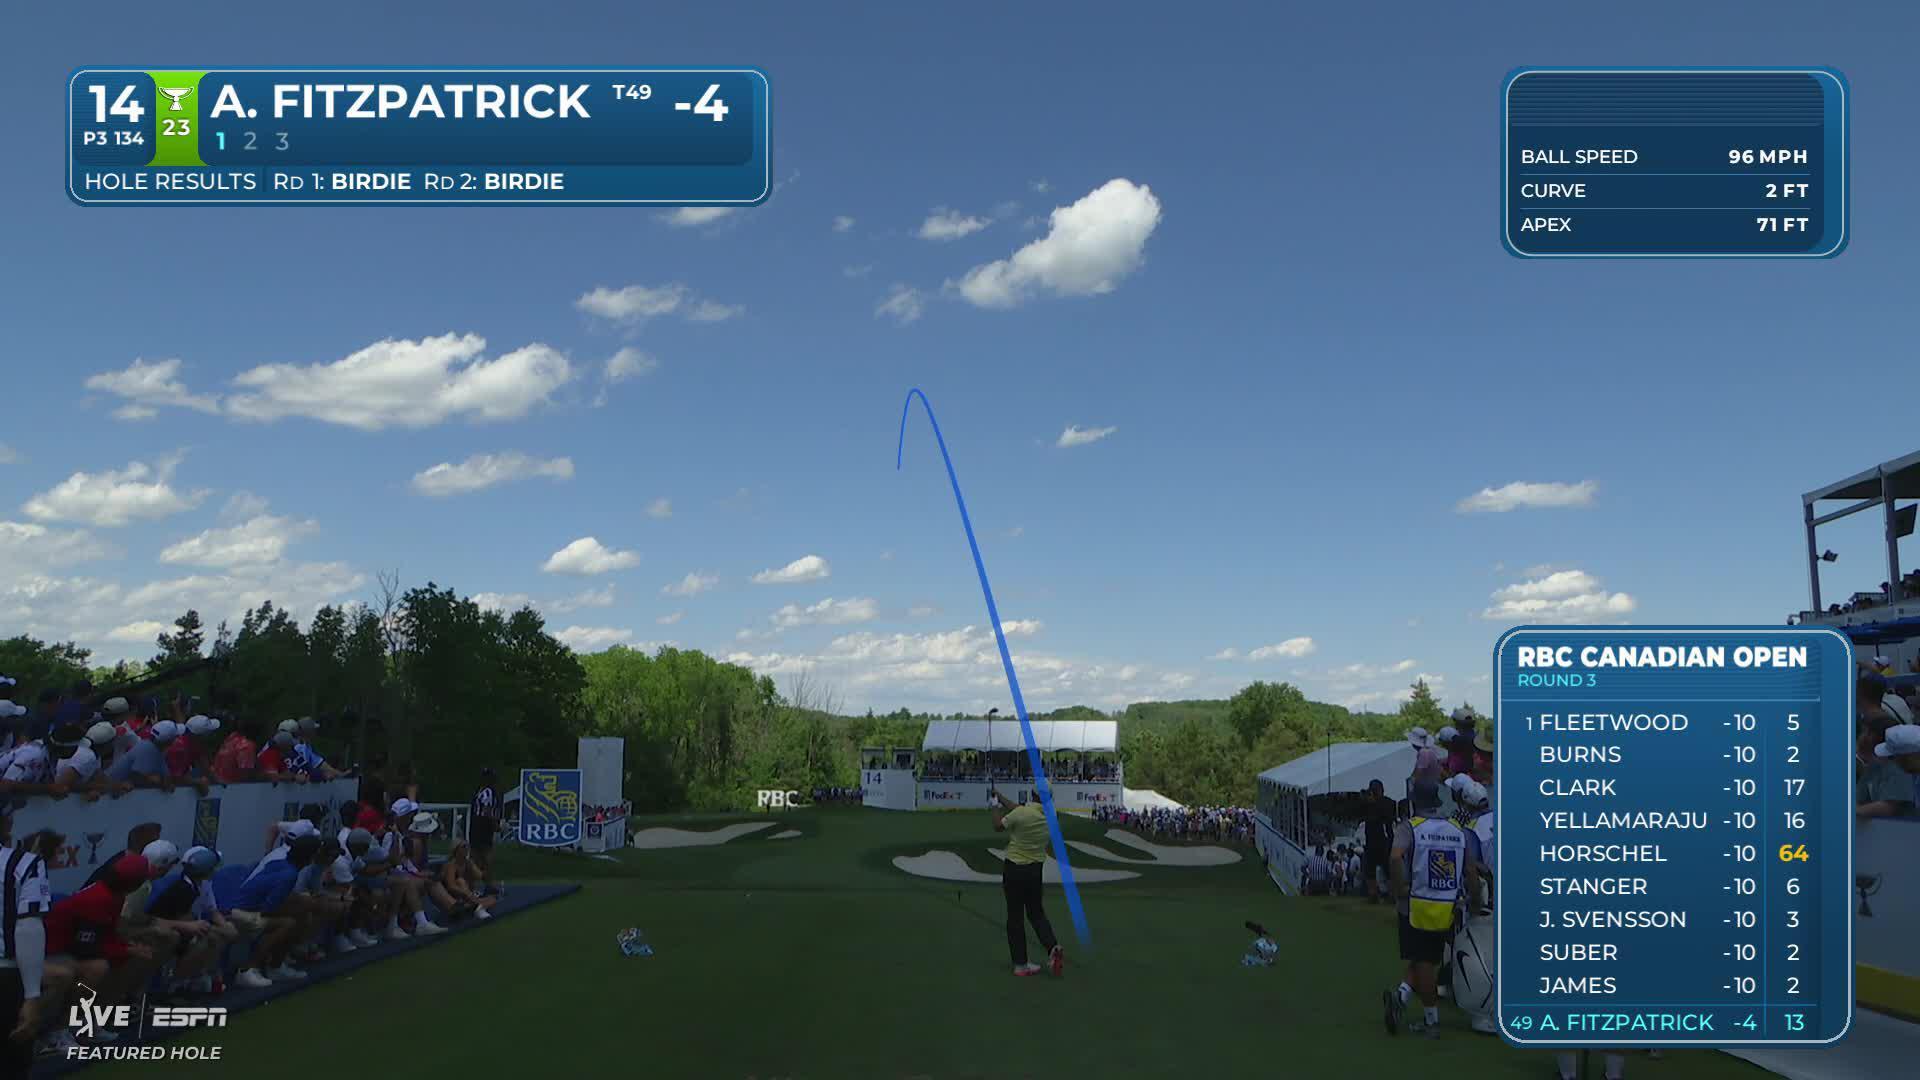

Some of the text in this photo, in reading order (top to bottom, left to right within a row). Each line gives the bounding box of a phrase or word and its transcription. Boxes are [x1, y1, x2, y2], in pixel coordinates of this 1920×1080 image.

[865, 772, 882, 785] 14
[757, 789, 799, 808] RBC
[527, 823, 577, 841] RBC
[1431, 878, 1455, 889] RBC
